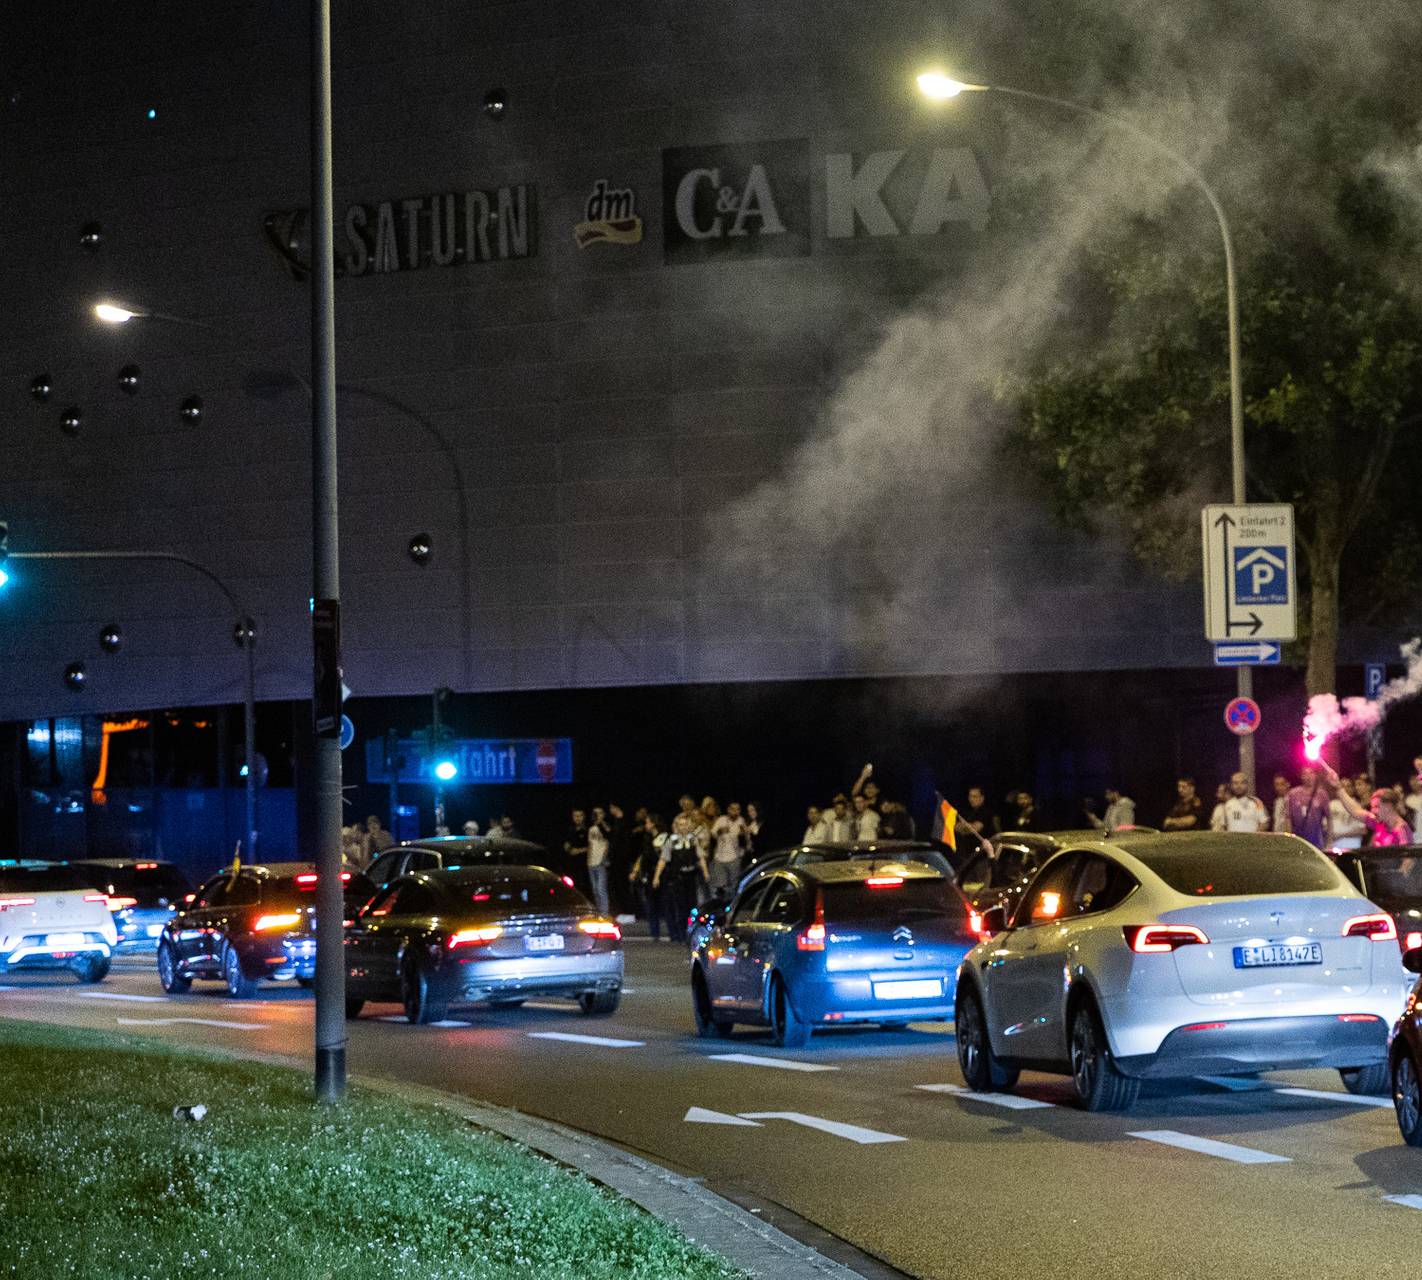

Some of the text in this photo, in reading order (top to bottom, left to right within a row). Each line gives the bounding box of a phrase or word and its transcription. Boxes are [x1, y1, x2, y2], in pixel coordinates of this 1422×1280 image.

[586, 179, 635, 223] dm
[676, 164, 787, 239] C&A
[346, 185, 528, 277] SATURN
[1240, 516, 1278, 527] Einfahrt
[1252, 563, 1274, 594] P
[1370, 669, 1381, 693] P
